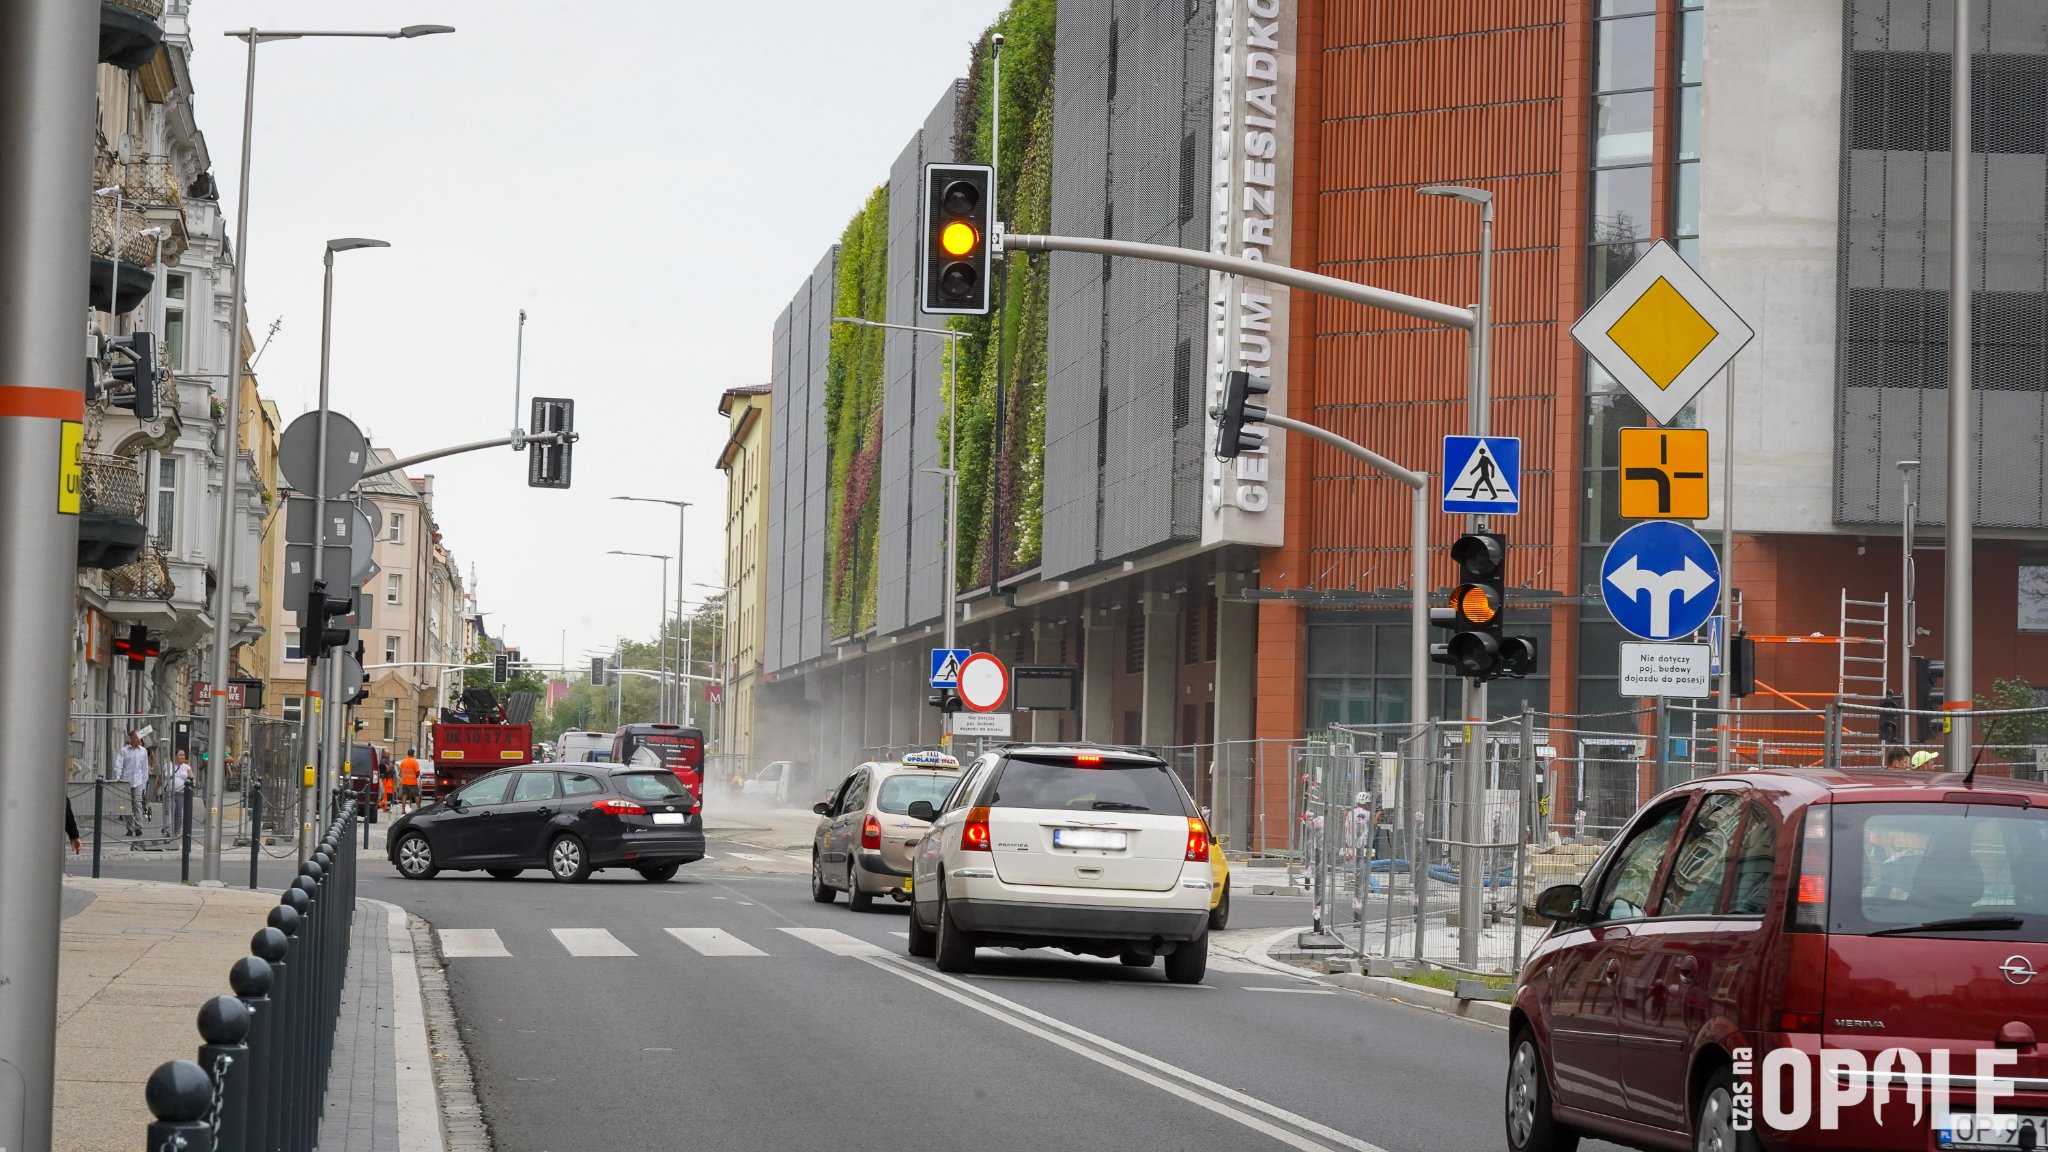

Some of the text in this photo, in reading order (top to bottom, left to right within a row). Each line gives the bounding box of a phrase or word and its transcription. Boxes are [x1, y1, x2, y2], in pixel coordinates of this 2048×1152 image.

[1235, 293, 1272, 512] CEUM
[1640, 654, 1690, 664] Nie dotyczy
[1639, 664, 1691, 673] poj. budowy
[1624, 674, 1705, 684] dojazdu do posesji
[1834, 1018, 1886, 1028] MERIVA
[1940, 1131, 1951, 1139] PL
